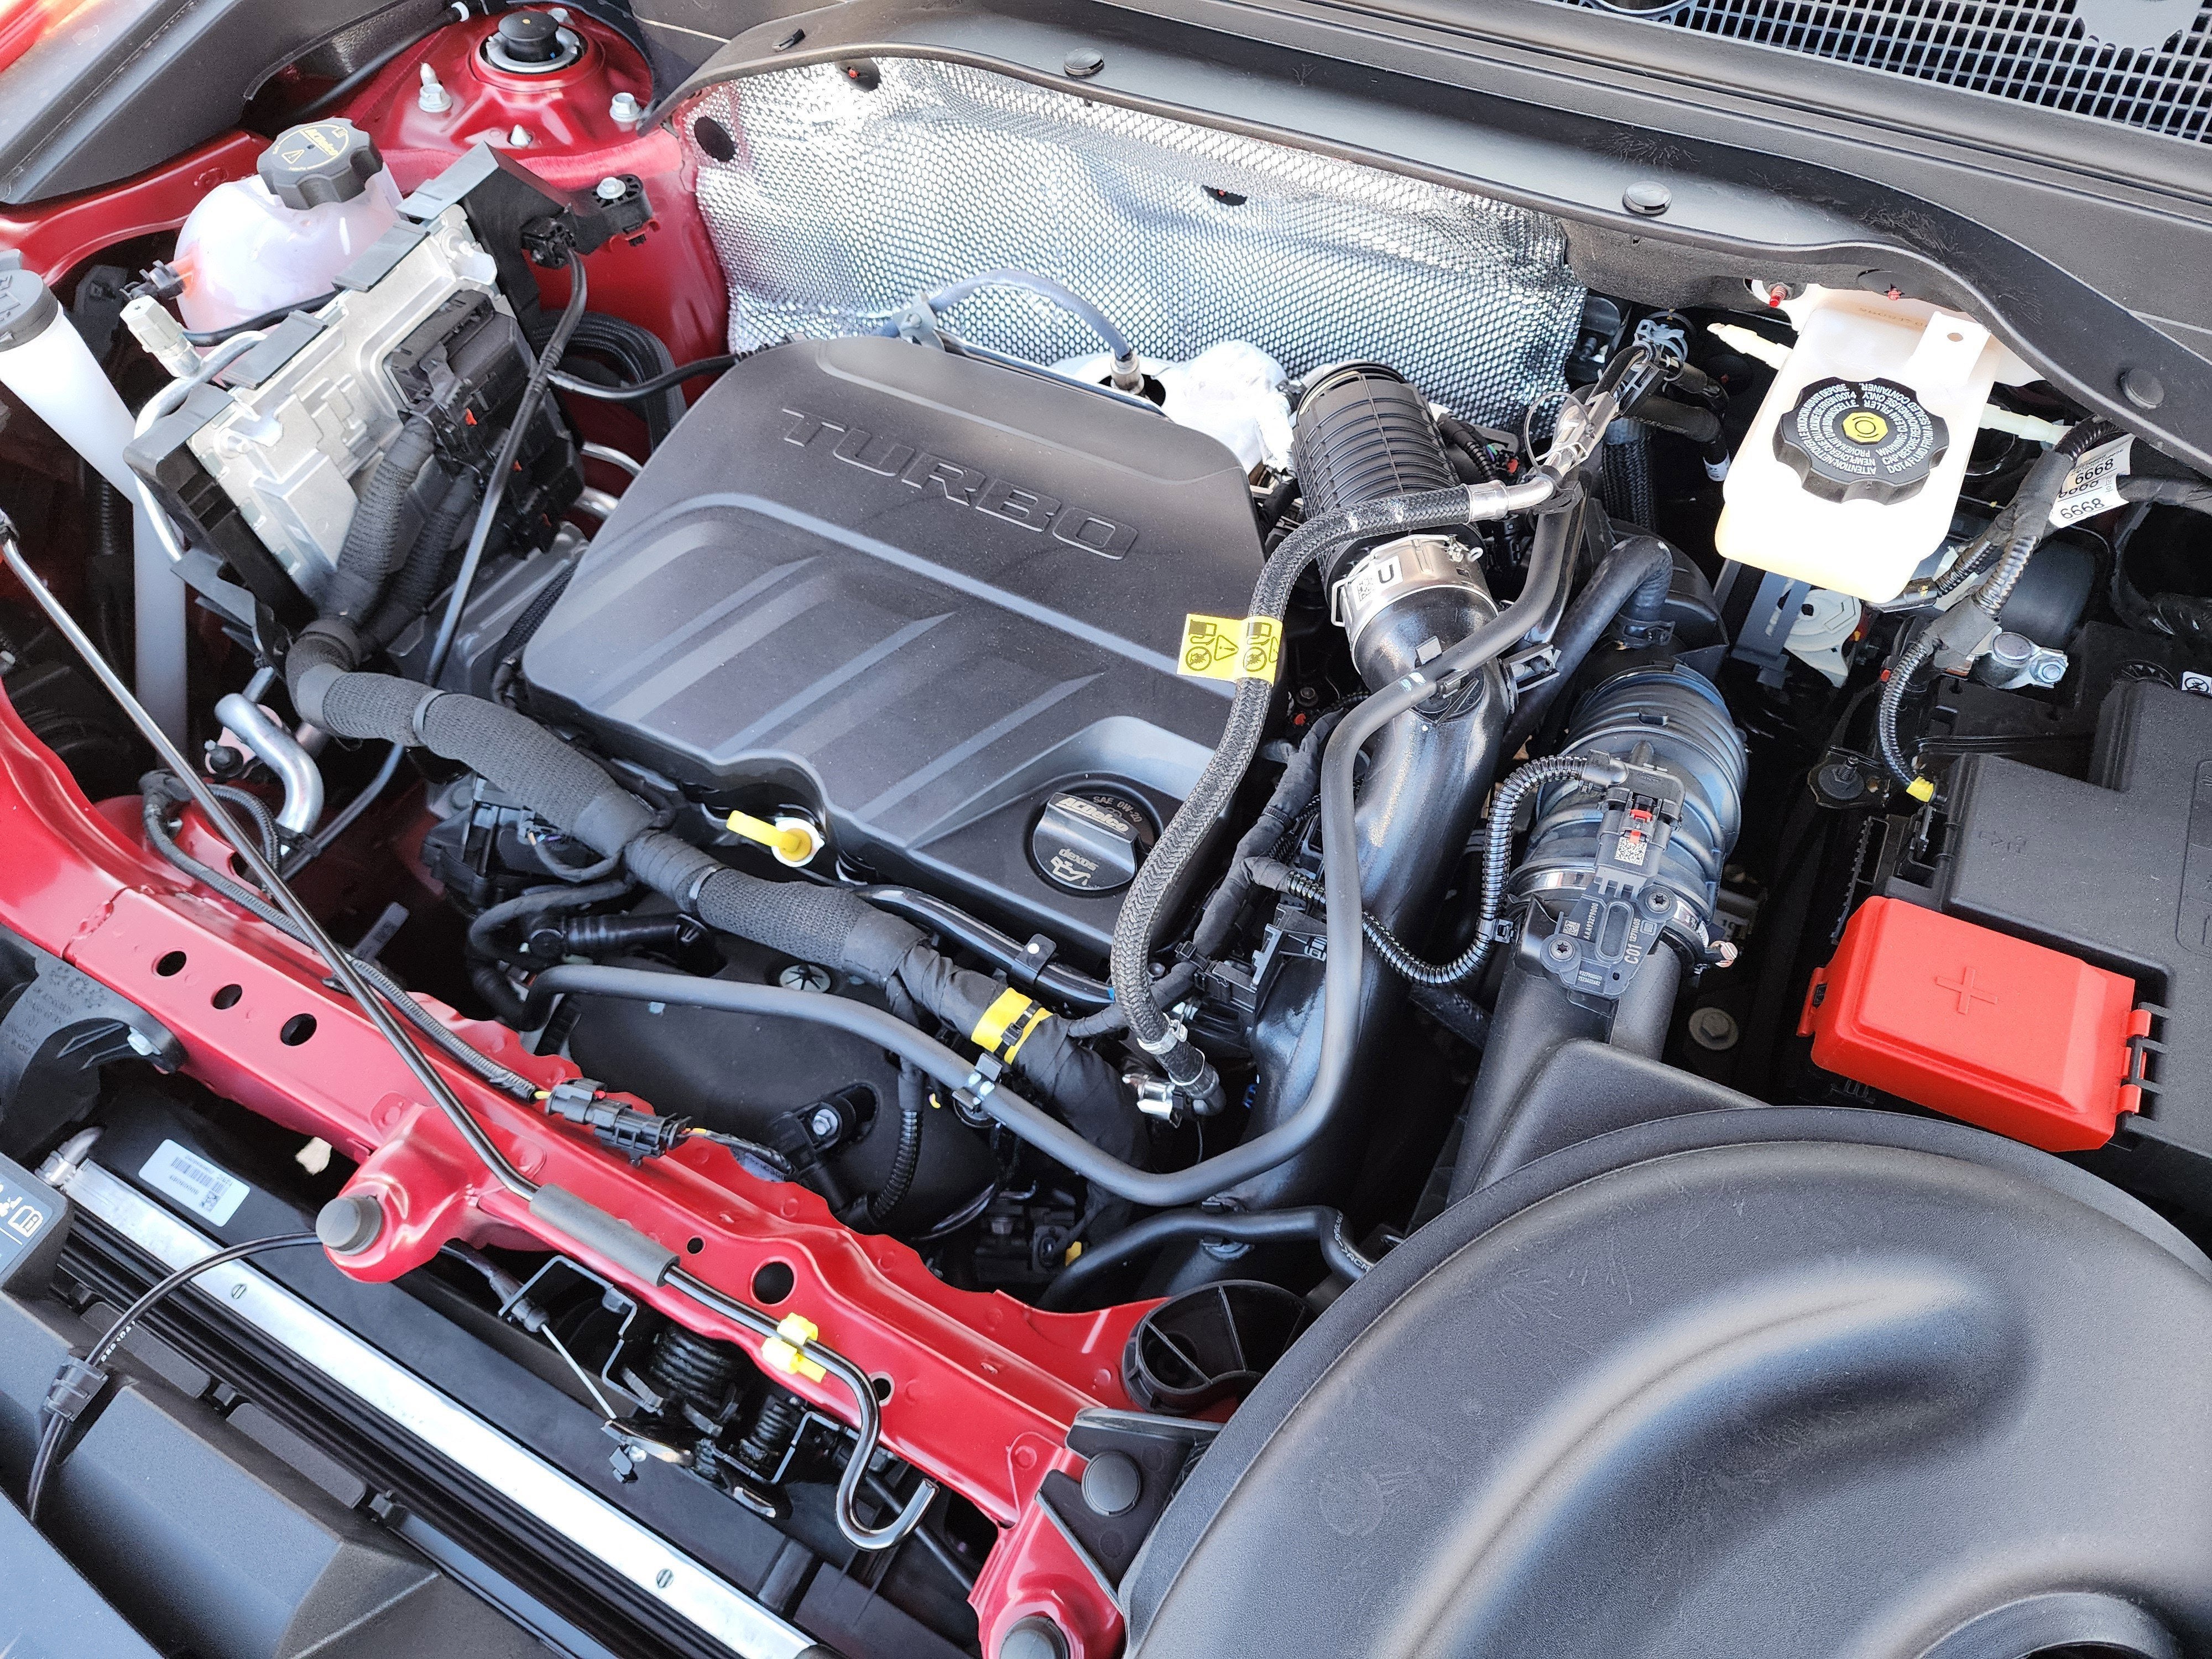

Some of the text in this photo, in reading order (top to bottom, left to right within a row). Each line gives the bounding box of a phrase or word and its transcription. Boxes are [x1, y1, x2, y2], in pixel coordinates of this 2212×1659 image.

[1861, 392, 1886, 401] ONLY
[1864, 400, 1894, 414] FILLER
[1888, 411, 1907, 432] CLEAN
[1906, 401, 1930, 424] SEALED
[1896, 437, 1919, 458] BEFORE
[1920, 431, 1933, 448] FROM
[1881, 454, 1901, 465] CAP
[2075, 458, 2114, 485] 6668
[781, 408, 1139, 561] TURBO
[2060, 498, 2105, 519] 6668
[1378, 564, 1394, 584] U
[1055, 797, 1129, 832] ACDelco
[1093, 796, 1143, 823] SAE 0W-20
[1058, 848, 1099, 871] dexos
